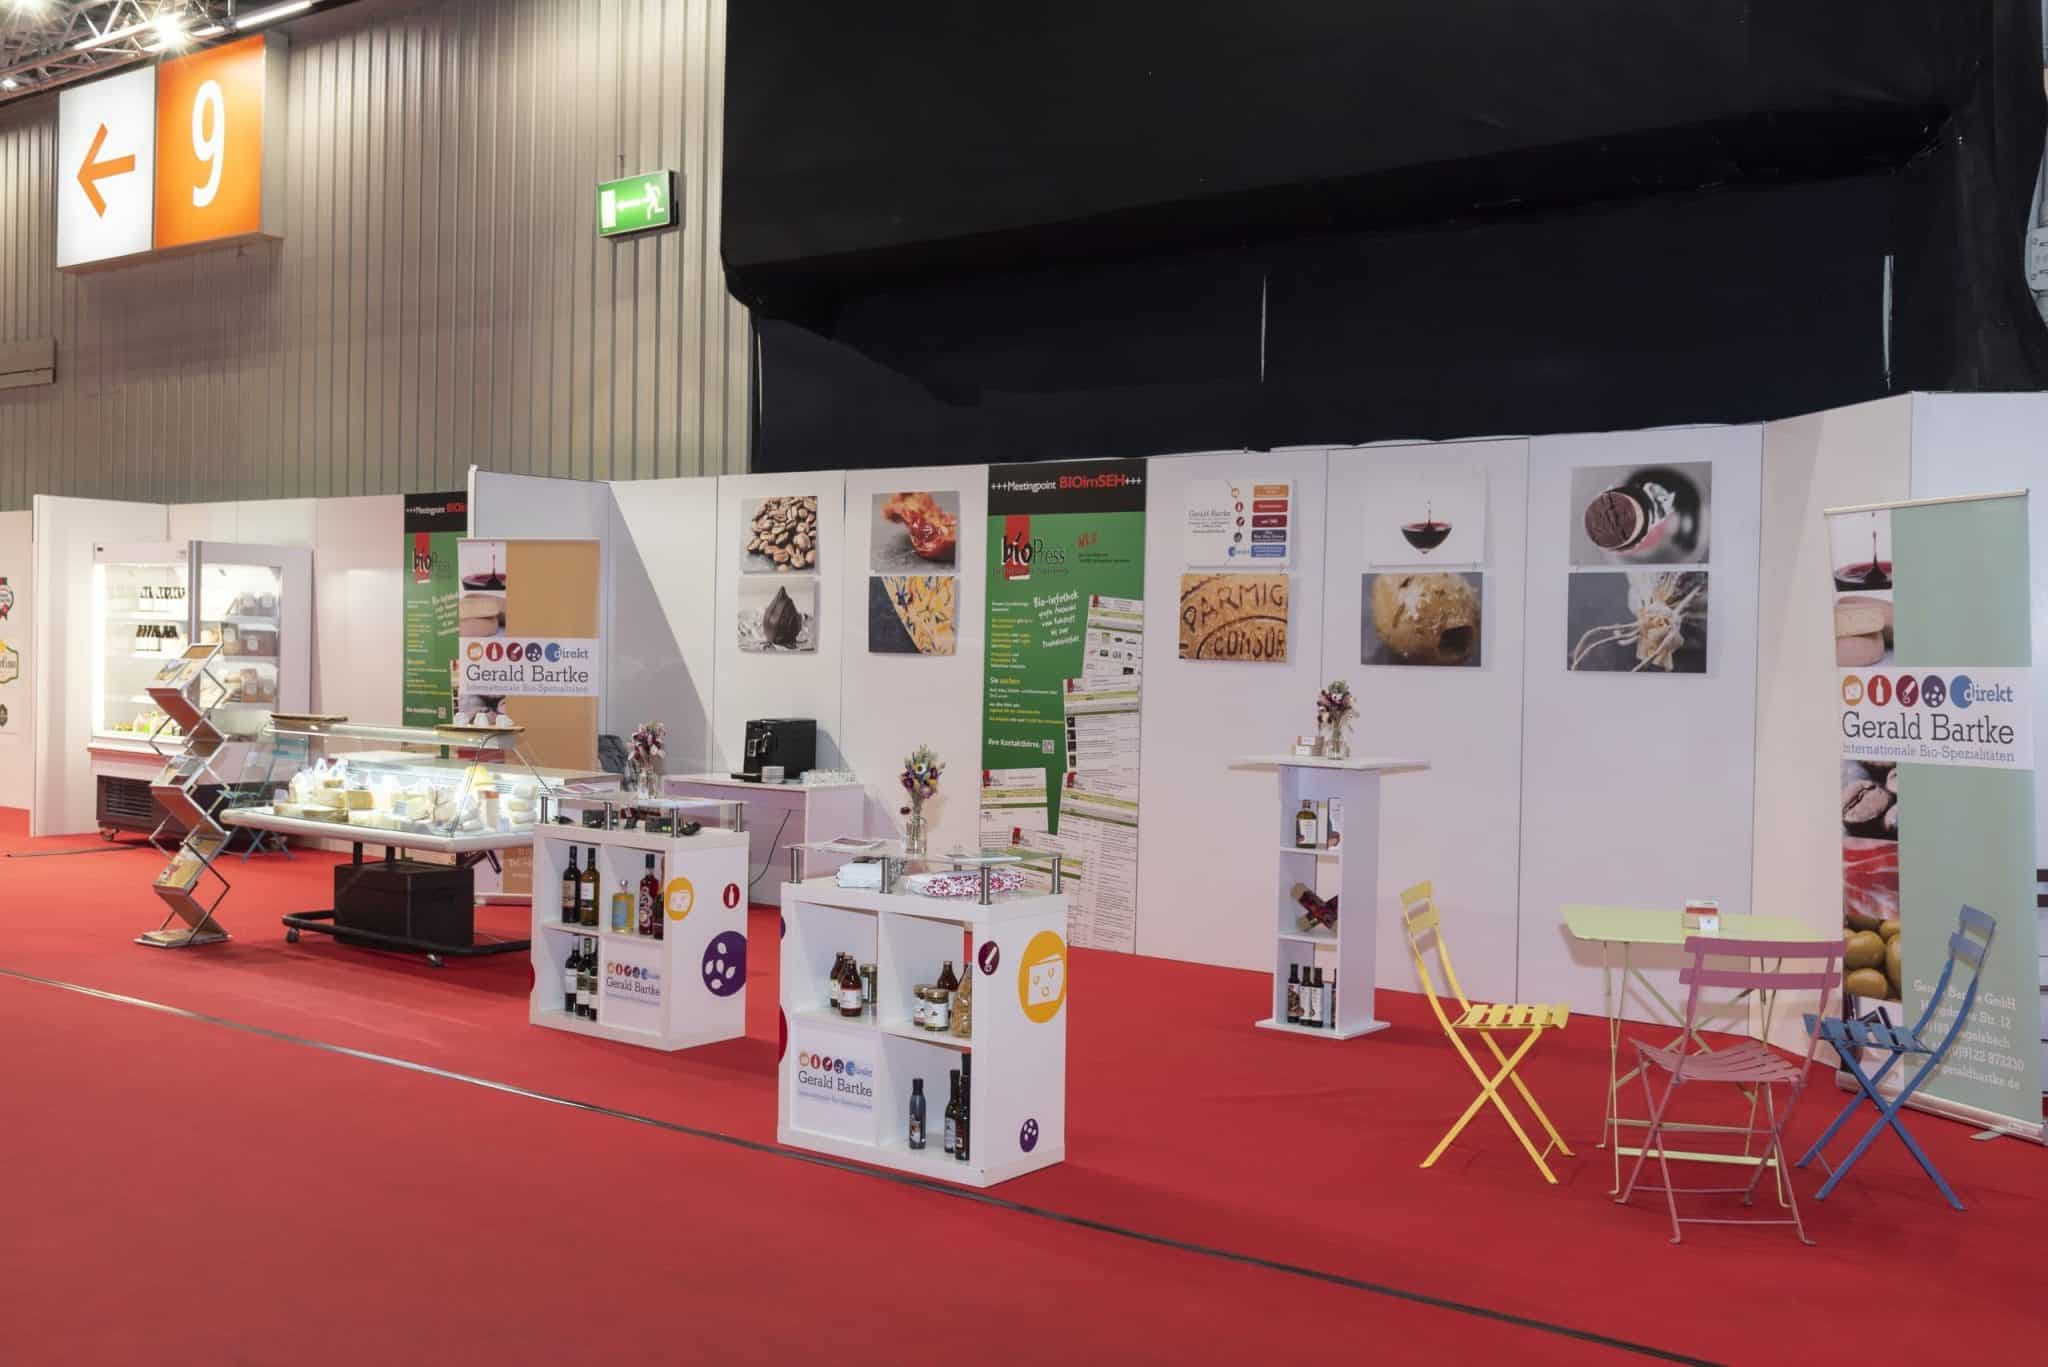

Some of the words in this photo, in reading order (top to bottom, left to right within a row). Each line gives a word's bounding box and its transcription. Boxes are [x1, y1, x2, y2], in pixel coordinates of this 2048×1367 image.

[191, 80, 226, 208] 9
[1183, 582, 1288, 633] PARMIG
[467, 664, 524, 681] Gerald
[532, 665, 589, 683] Bartke
[1842, 711, 1921, 740] Gerald
[1931, 714, 2015, 745] Bartke
[1842, 743, 1915, 757] Internationale
[607, 976, 632, 992] Gerald
[634, 981, 661, 997] Bartke
[799, 1070, 833, 1089] Gerald
[837, 1078, 873, 1097] Bartke
